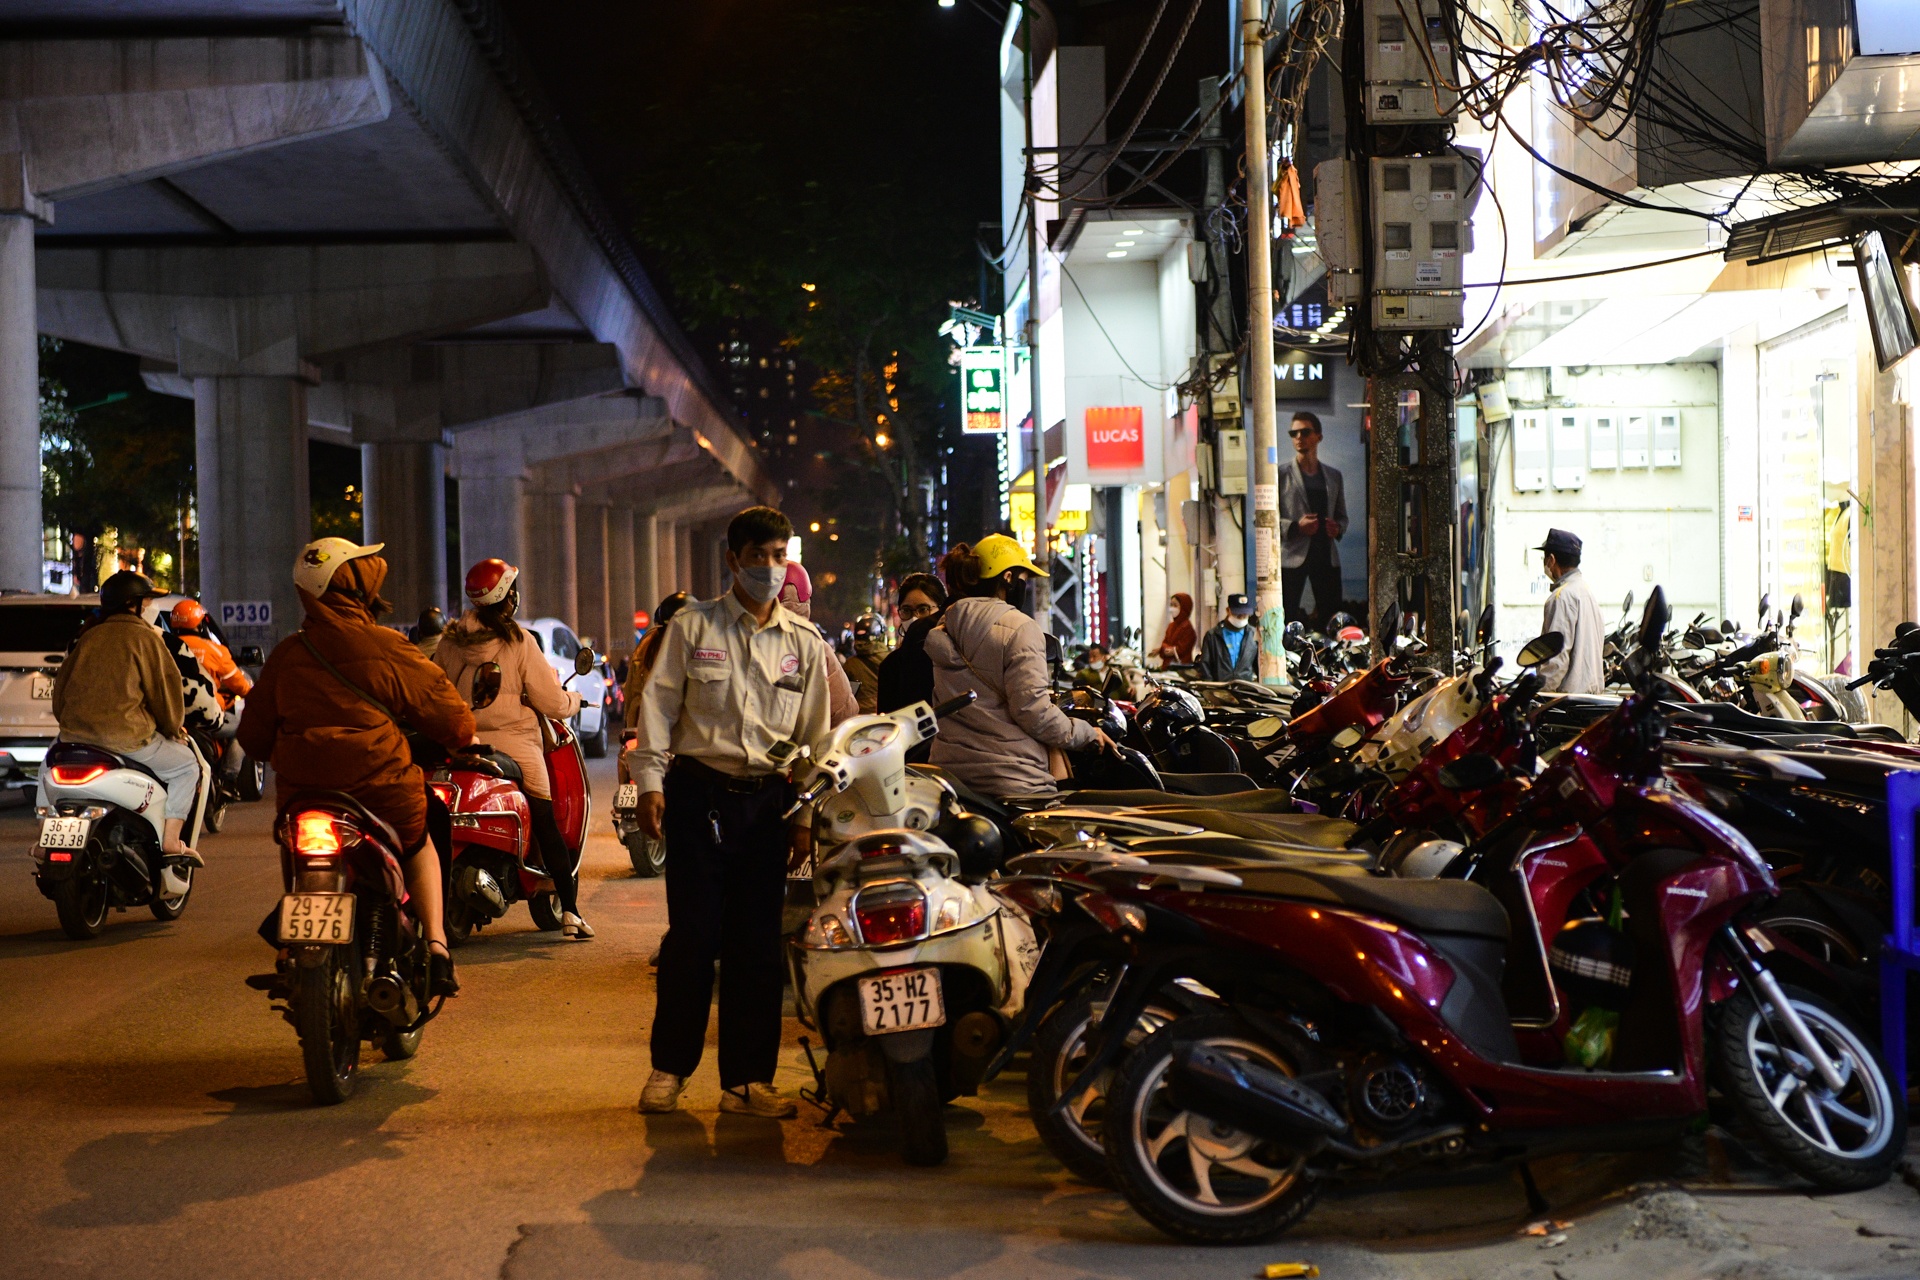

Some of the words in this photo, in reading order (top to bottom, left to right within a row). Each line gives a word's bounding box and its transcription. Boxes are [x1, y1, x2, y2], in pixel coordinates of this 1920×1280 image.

[1273, 363, 1323, 380] WEN
[1092, 429, 1139, 443] LUCAS
[223, 604, 270, 623] P330
[48, 820, 83, 833] 36-F1
[42, 834, 84, 847] 363.38
[291, 897, 343, 916] 29-Z4
[289, 919, 341, 939] 5976
[871, 974, 929, 1003] 35-H2
[874, 1000, 930, 1029] 2177
